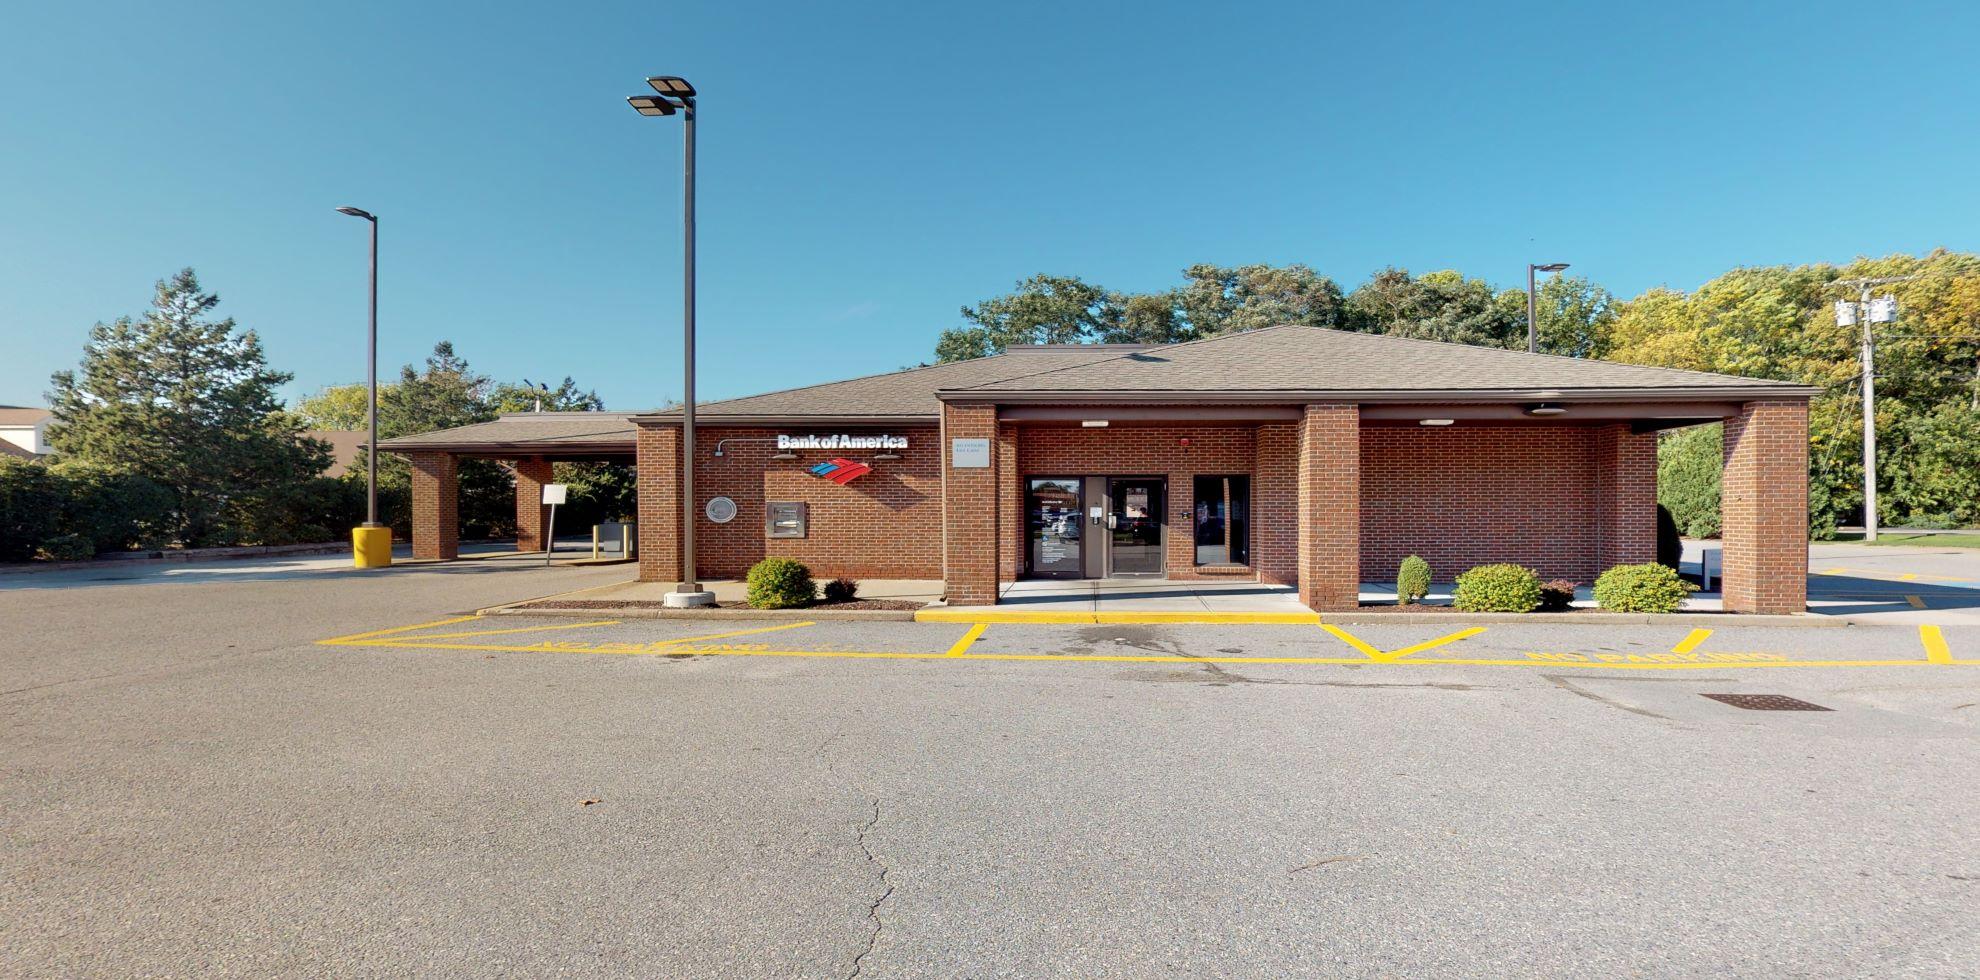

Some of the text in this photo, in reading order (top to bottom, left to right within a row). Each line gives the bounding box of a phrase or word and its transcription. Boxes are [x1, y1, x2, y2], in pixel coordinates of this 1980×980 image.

[777, 434, 908, 449] Bank of America
[1525, 652, 1787, 664] NO PARKING
